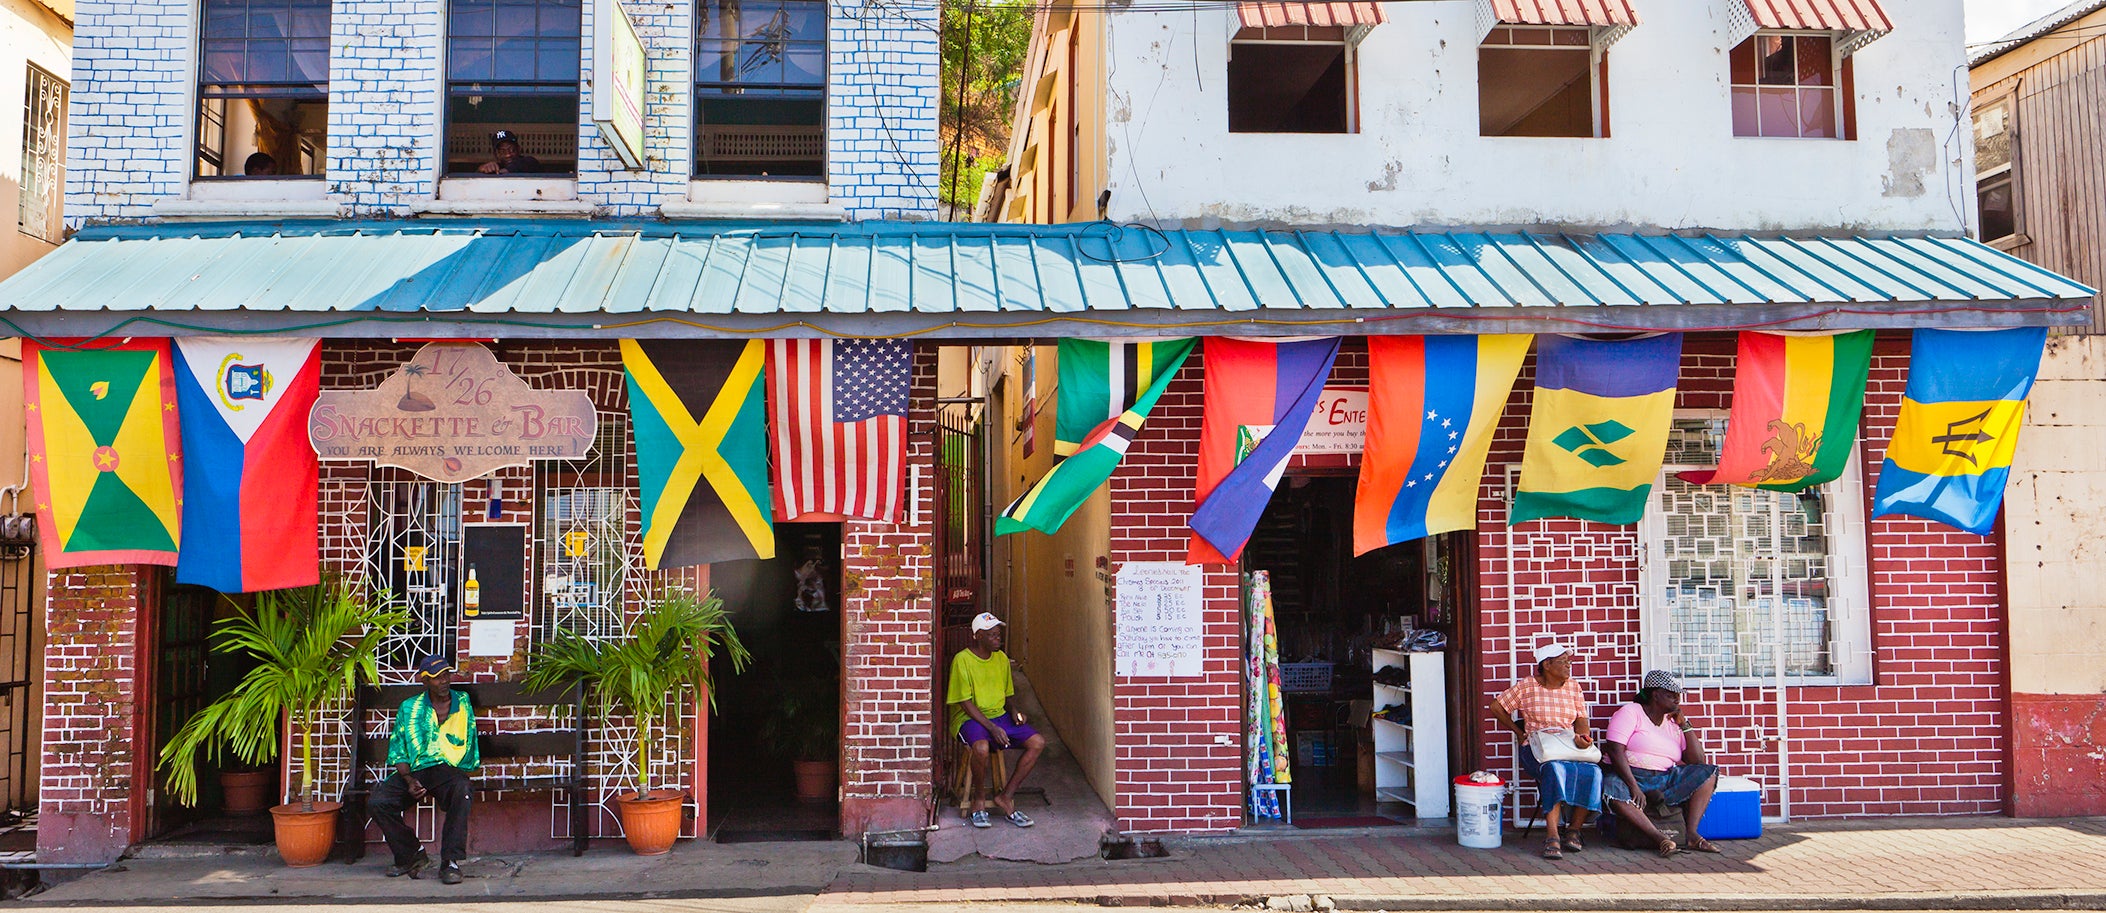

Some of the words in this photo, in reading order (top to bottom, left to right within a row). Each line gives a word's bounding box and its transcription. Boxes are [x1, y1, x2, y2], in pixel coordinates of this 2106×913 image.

[312, 404, 485, 440] SNACKETTE
[510, 404, 593, 440] BAR
[1346, 429, 1358, 438] buy
[327, 446, 350, 456] YOU
[358, 446, 384, 456] ARE
[392, 446, 445, 456] ALWAYS
